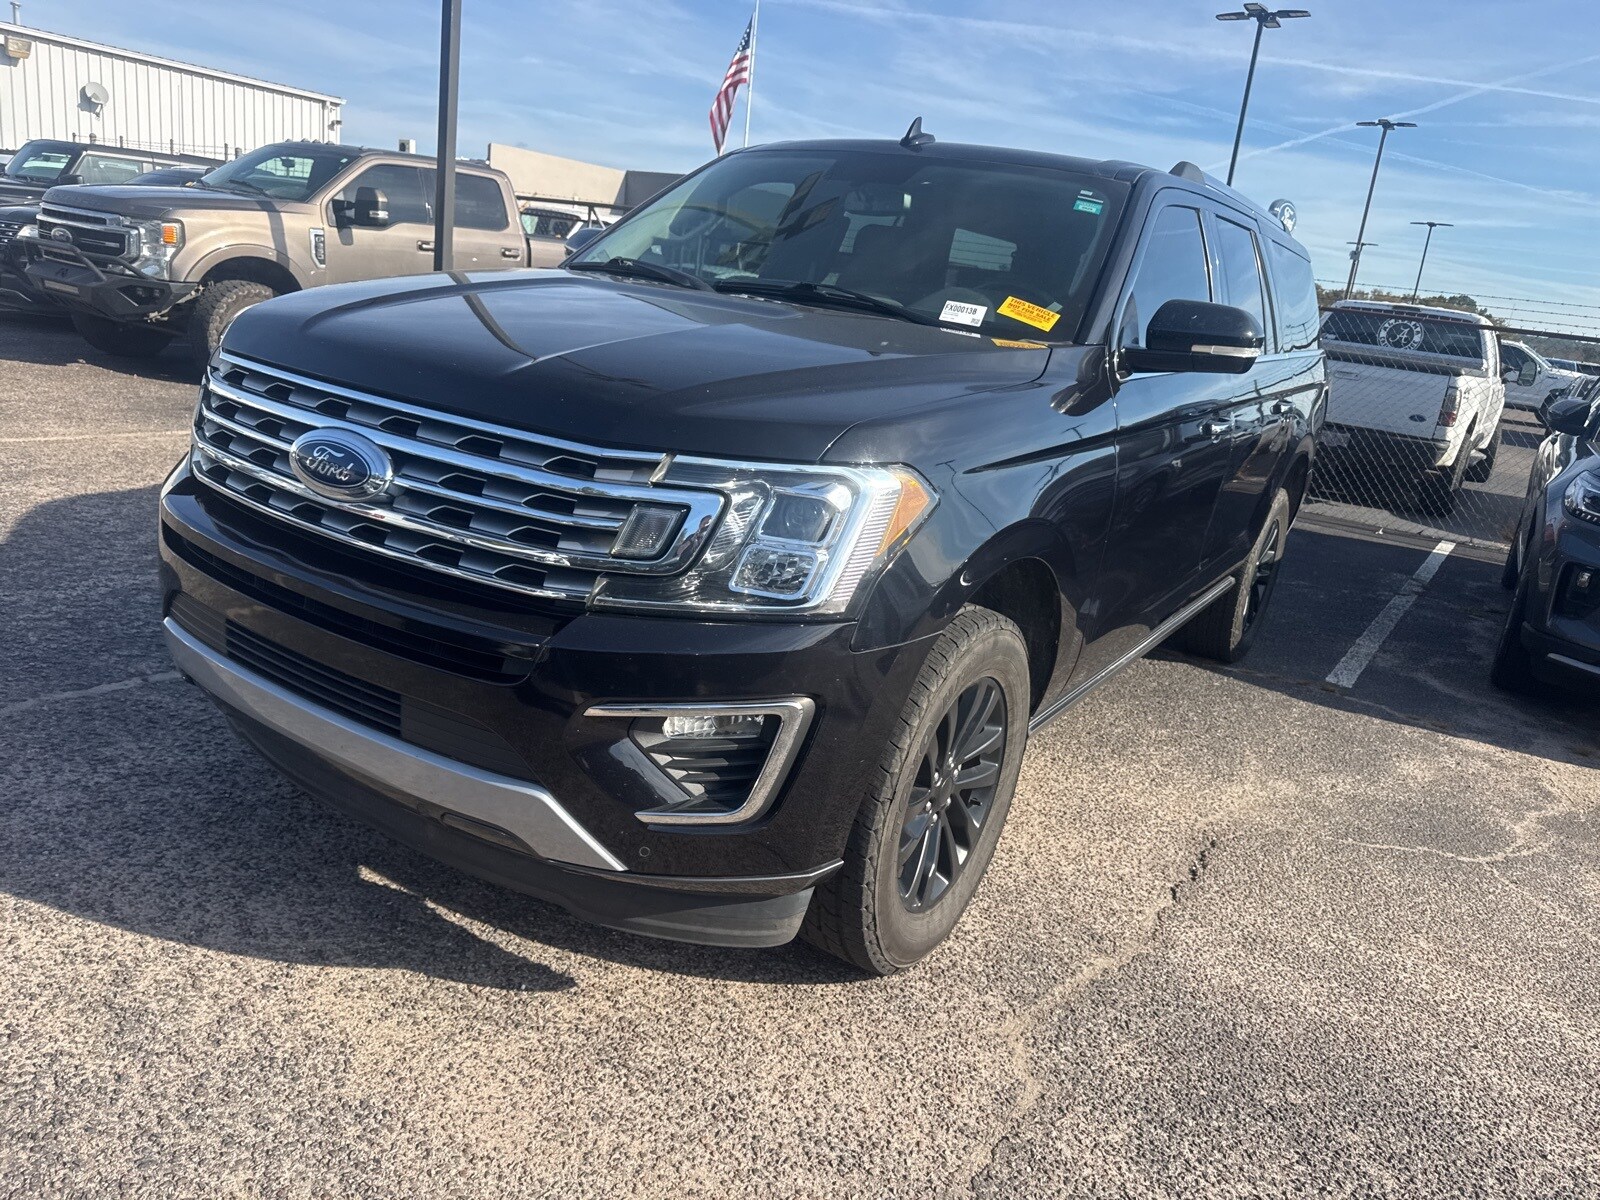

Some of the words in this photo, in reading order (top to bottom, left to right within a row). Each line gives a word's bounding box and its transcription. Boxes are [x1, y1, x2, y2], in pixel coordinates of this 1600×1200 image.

[1008, 302, 1021, 310] NOT
[1021, 307, 1035, 315] FOR
[1036, 312, 1052, 322] SALE
[1010, 298, 1026, 307] THIS
[1027, 303, 1057, 319] VEHICLE
[306, 445, 355, 482] Ford
